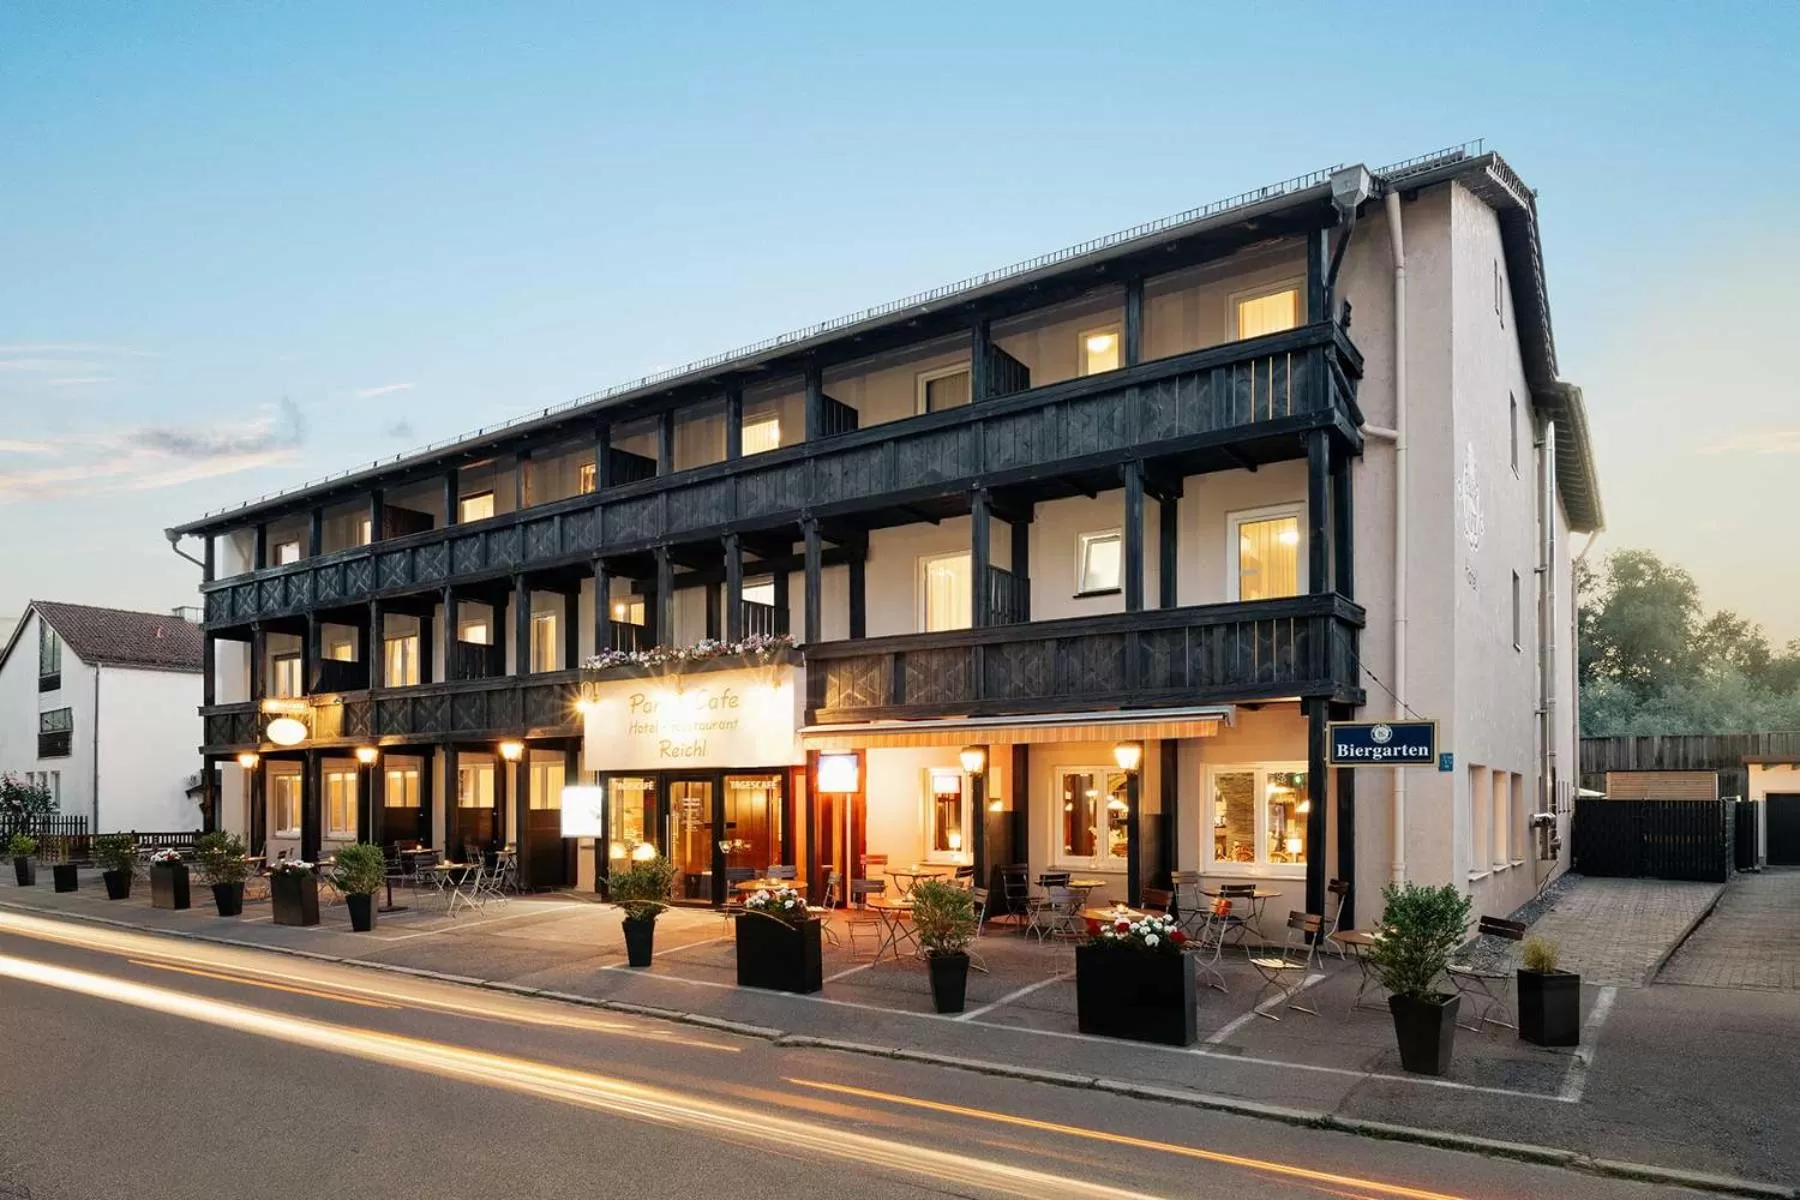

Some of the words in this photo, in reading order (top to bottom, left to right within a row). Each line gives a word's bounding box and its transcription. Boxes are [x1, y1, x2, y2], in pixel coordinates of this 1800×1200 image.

[629, 692, 667, 715] Par
[628, 721, 658, 736] Hotel
[672, 717, 740, 734] Rtaurant
[658, 738, 707, 758] Reichl
[1336, 743, 1429, 760] Biergarten
